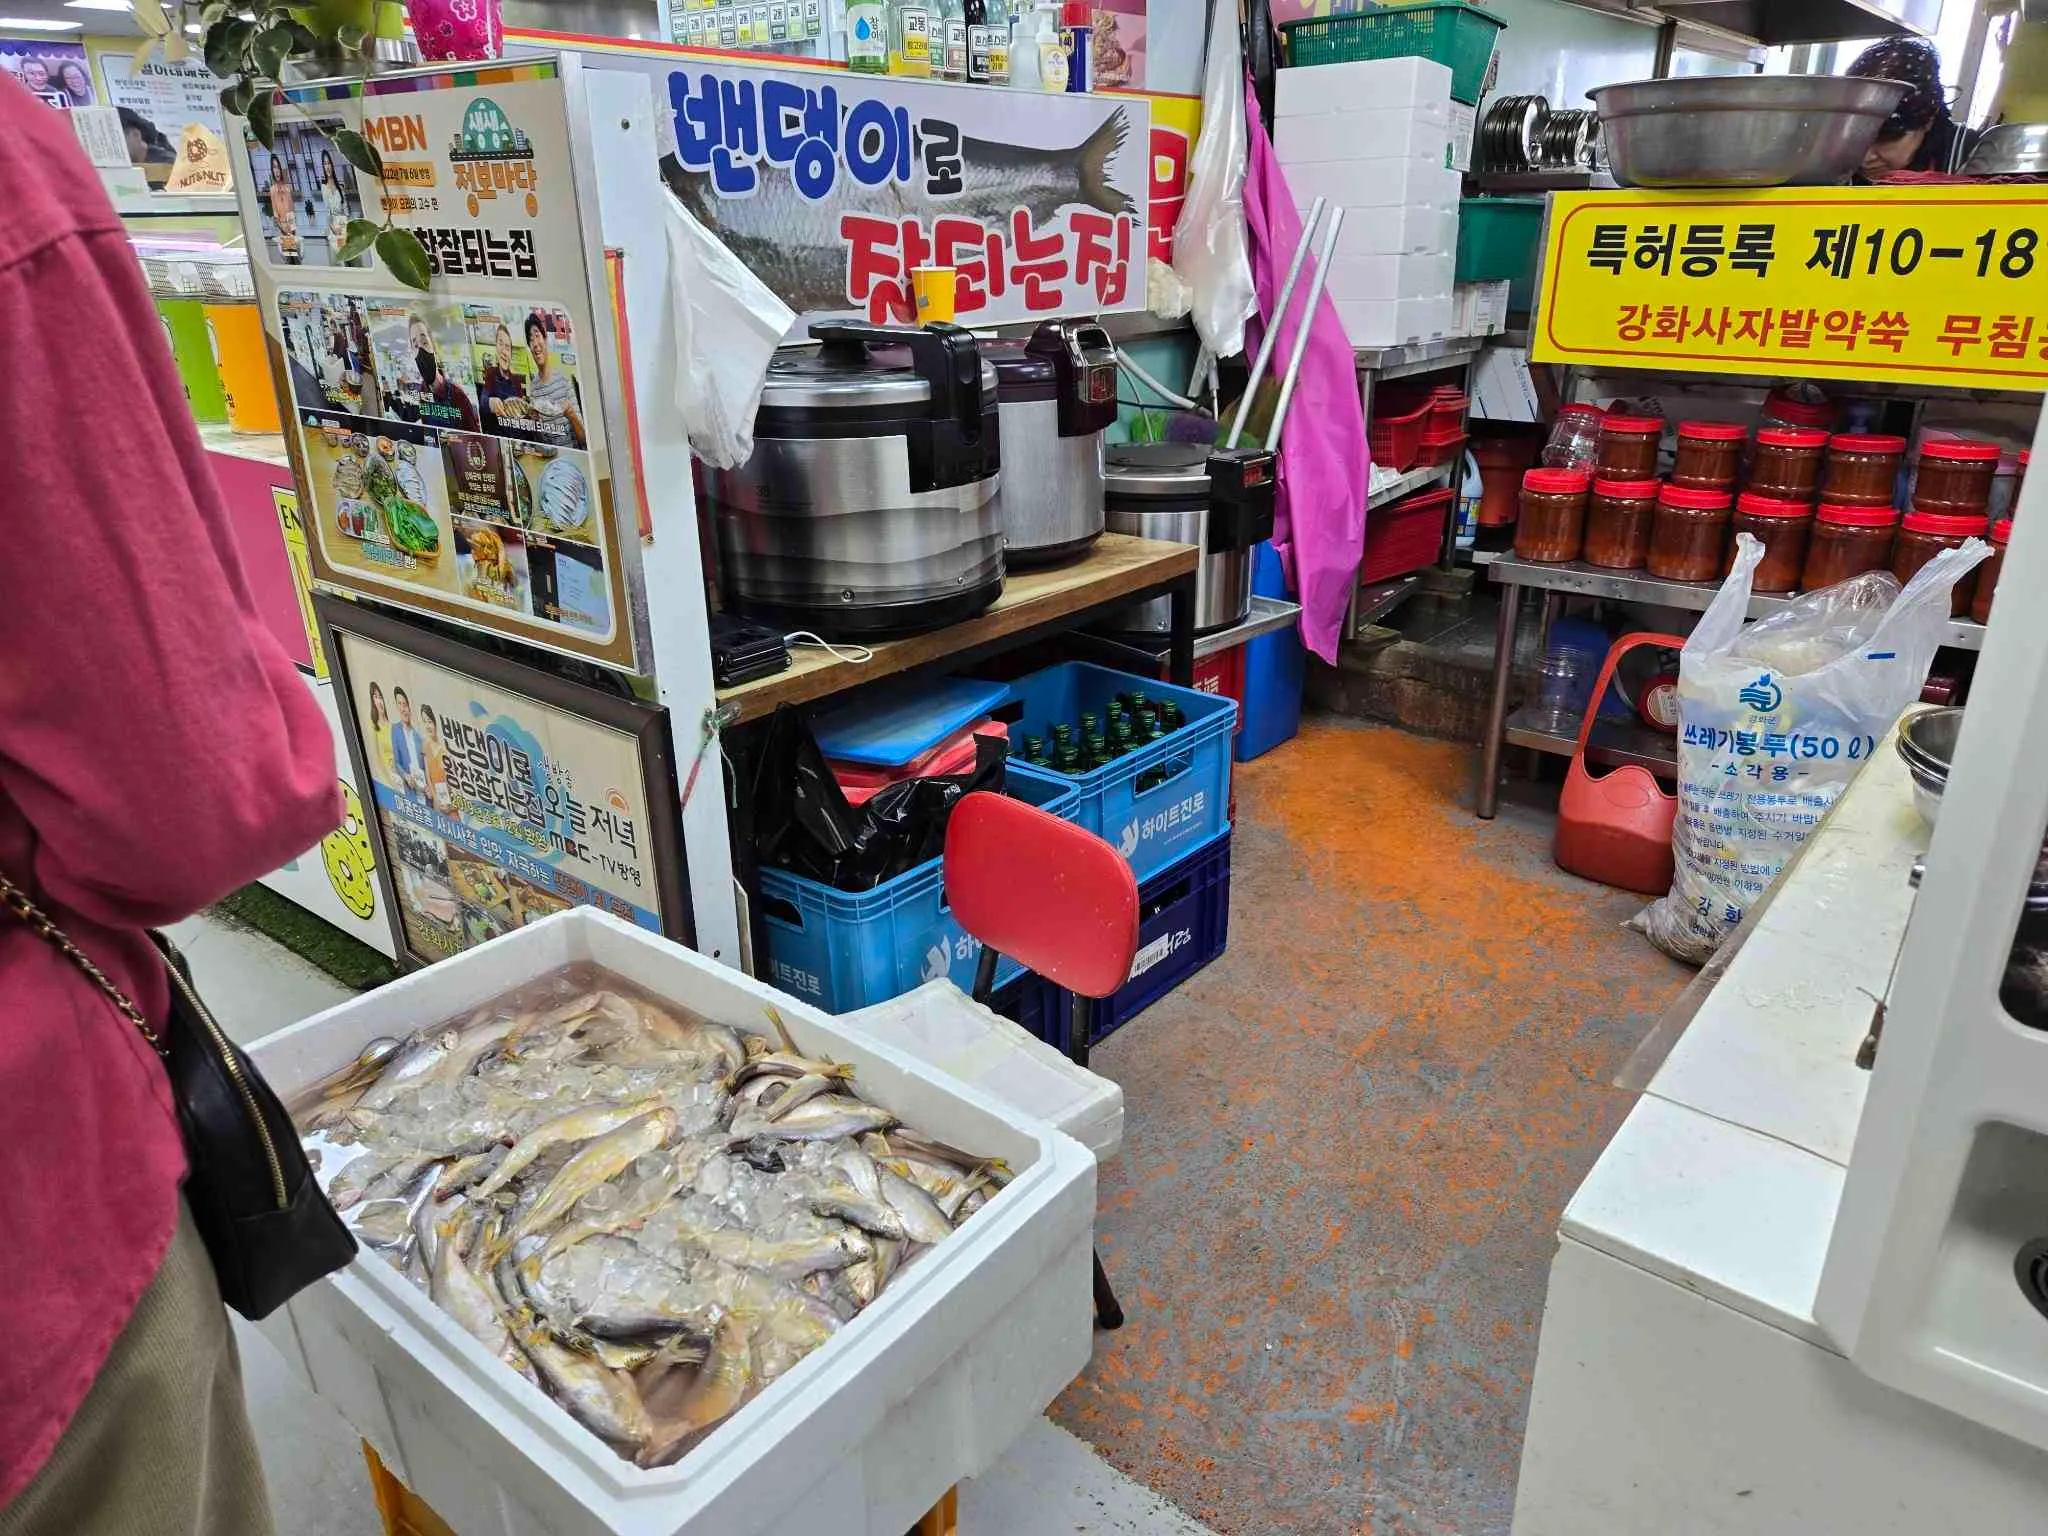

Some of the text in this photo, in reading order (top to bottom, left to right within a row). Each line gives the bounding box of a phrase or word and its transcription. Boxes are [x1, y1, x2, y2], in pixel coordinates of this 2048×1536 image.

[365, 115, 428, 151] MBN
[1587, 223, 2047, 279] 특허등록 제10-18
[1615, 304, 2048, 360] 강화사자발약쑥 무침
[440, 714, 534, 787] 밴댕이로
[545, 784, 586, 835] 오늘
[590, 804, 637, 860] 저녁
[1142, 791, 1205, 840] 하이트진로
